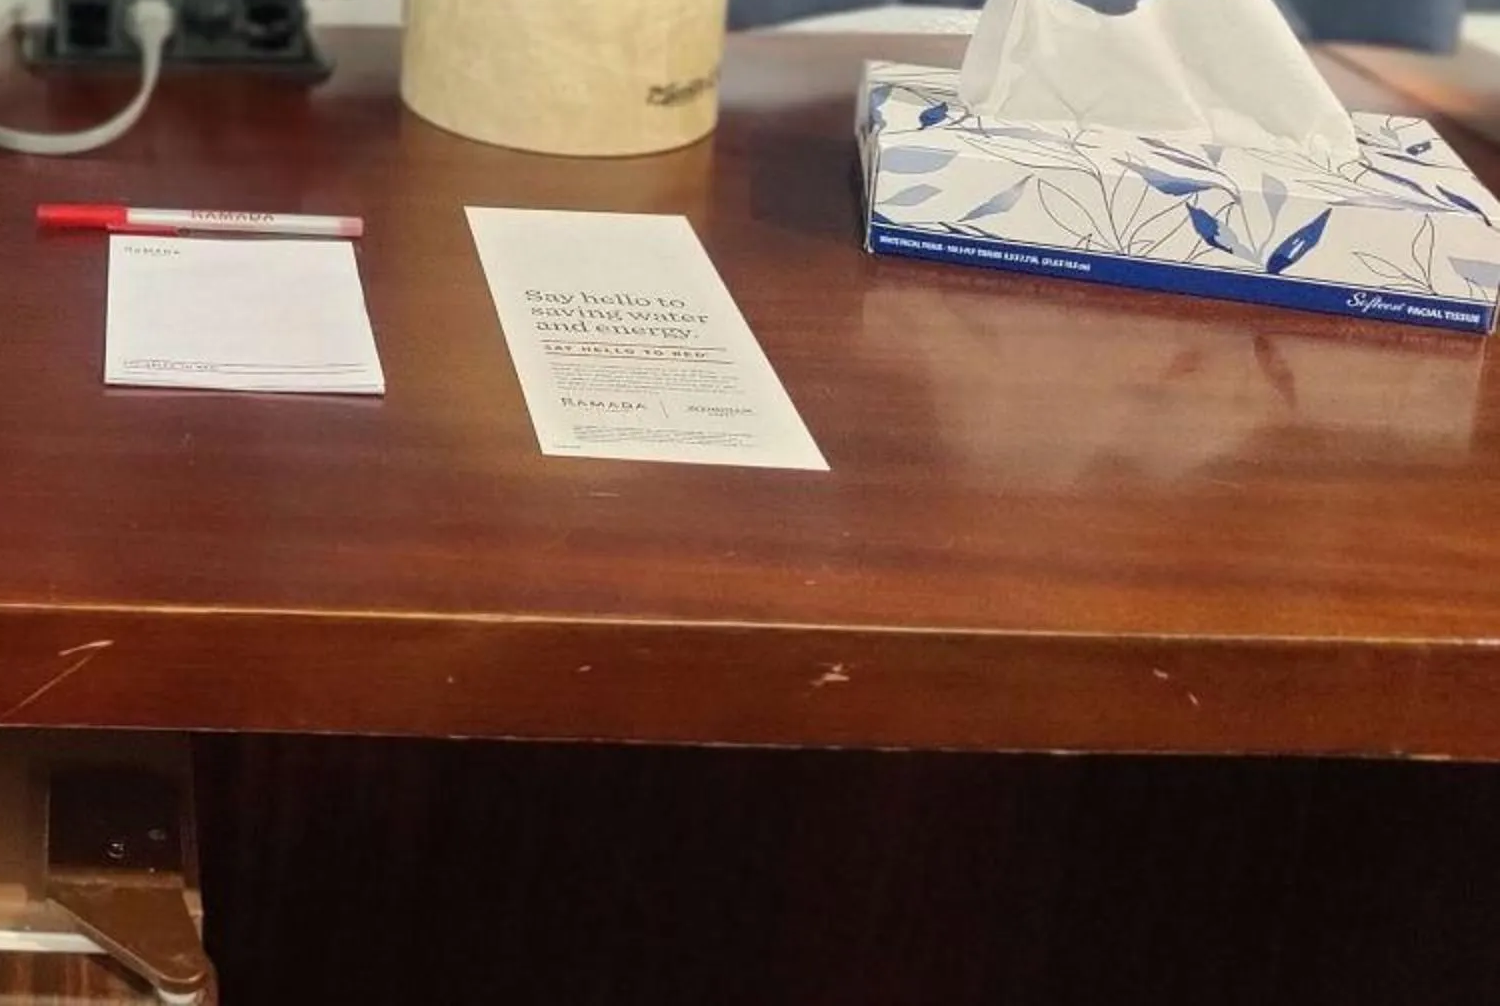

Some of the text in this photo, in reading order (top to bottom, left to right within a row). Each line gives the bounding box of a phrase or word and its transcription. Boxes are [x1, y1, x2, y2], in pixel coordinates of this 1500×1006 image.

[525, 289, 685, 308] Say hello to
[531, 306, 709, 323] saving water
[1407, 305, 1443, 319] FACIAL
[536, 321, 700, 339] and energy.
